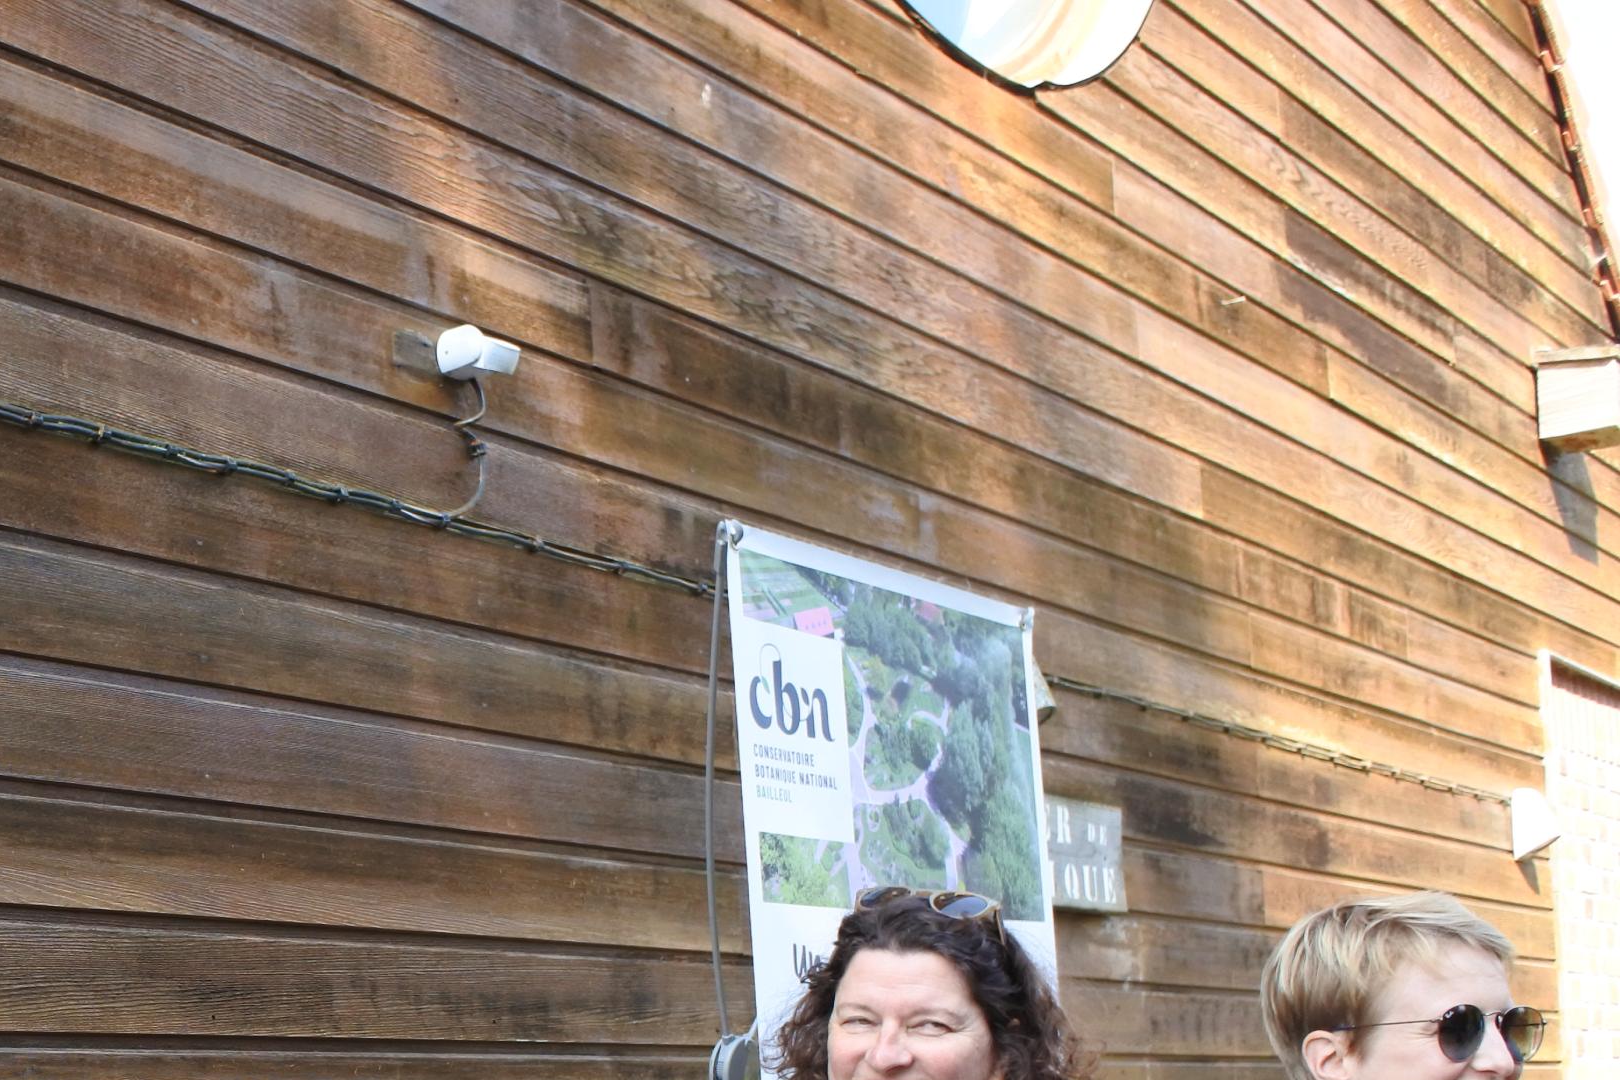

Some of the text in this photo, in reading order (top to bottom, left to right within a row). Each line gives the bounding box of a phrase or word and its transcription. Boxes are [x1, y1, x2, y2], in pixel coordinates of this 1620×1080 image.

[753, 743, 815, 767] CONSERVATOIRE
[755, 764, 838, 791] BOTANIQUE NATIONAL
[1087, 823, 1108, 846] DE
